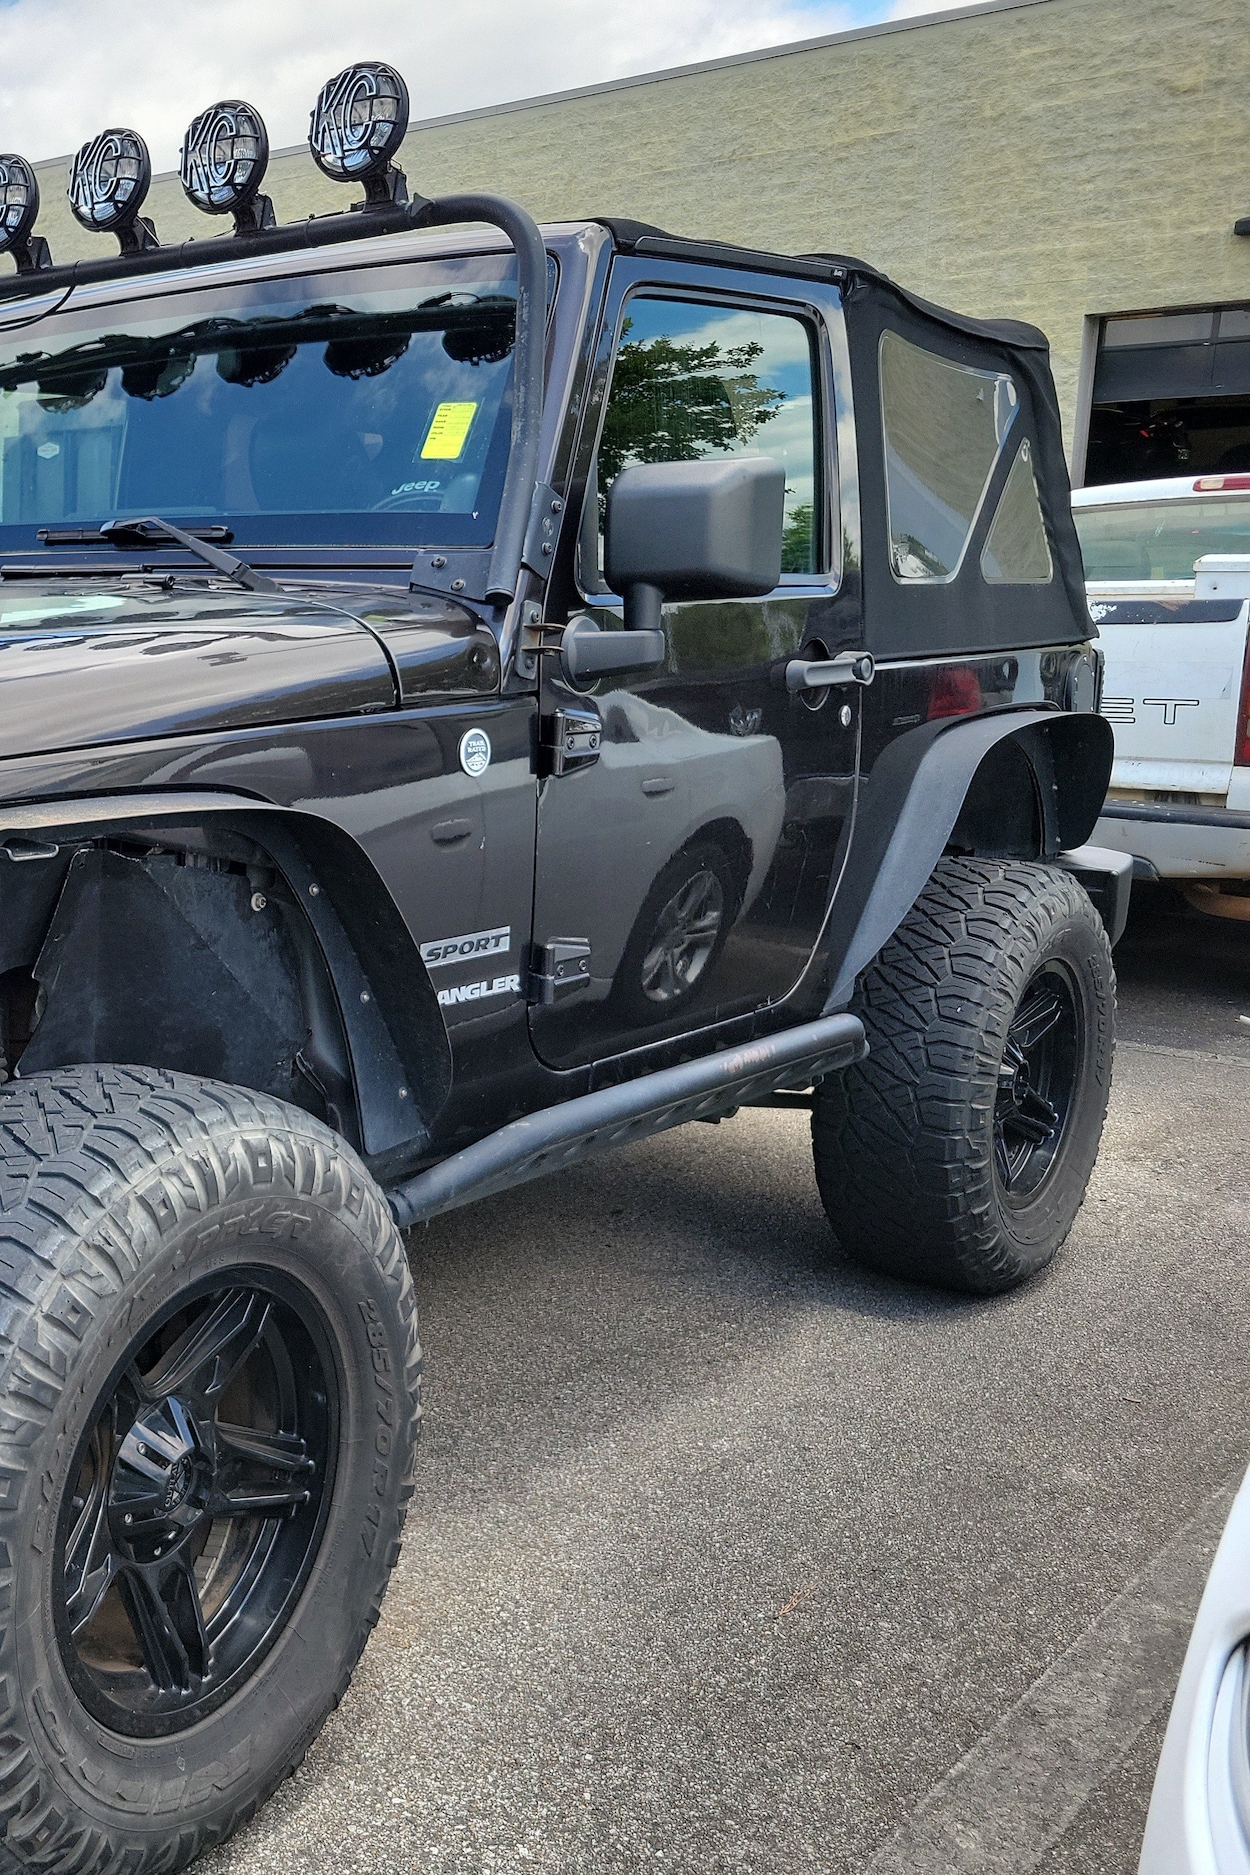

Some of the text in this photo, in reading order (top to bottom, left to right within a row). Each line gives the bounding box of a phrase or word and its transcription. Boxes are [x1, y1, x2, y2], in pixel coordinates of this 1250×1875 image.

[180, 110, 237, 194] KC
[312, 69, 377, 158] KC
[69, 132, 121, 210] KC
[393, 482, 440, 495] Jeep
[424, 933, 510, 962] SPORT
